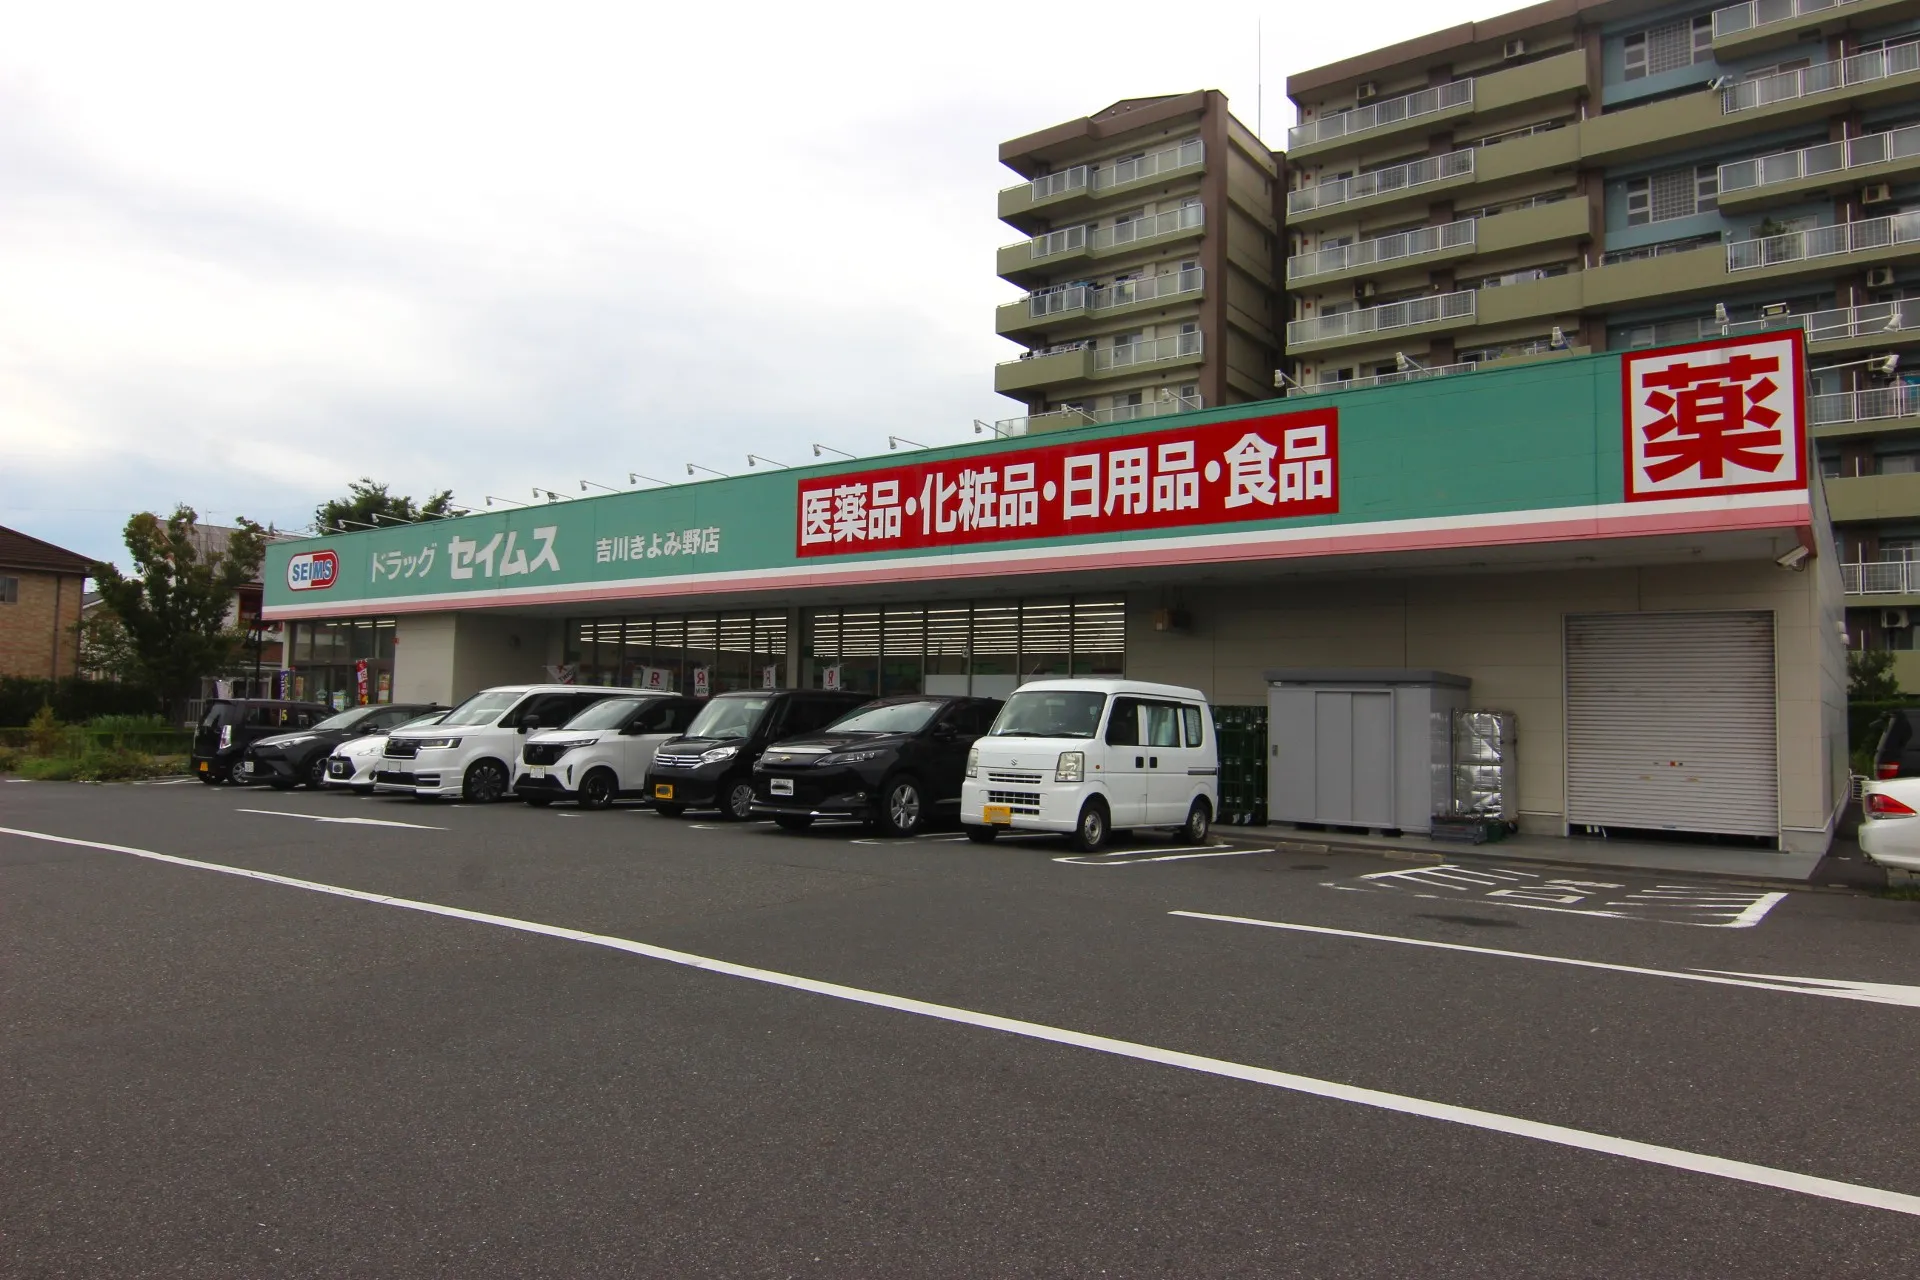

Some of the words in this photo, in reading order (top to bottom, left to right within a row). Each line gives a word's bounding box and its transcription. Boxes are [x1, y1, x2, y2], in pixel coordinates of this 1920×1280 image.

[1642, 354, 1784, 483] 薬
[801, 425, 1332, 546] 医薬品・化粧品・日用品・食品
[292, 559, 333, 582] SEIMS
[370, 542, 438, 583] ドラッグ
[448, 526, 560, 580] セイムス
[596, 526, 721, 563] 吉川きよみ野店
